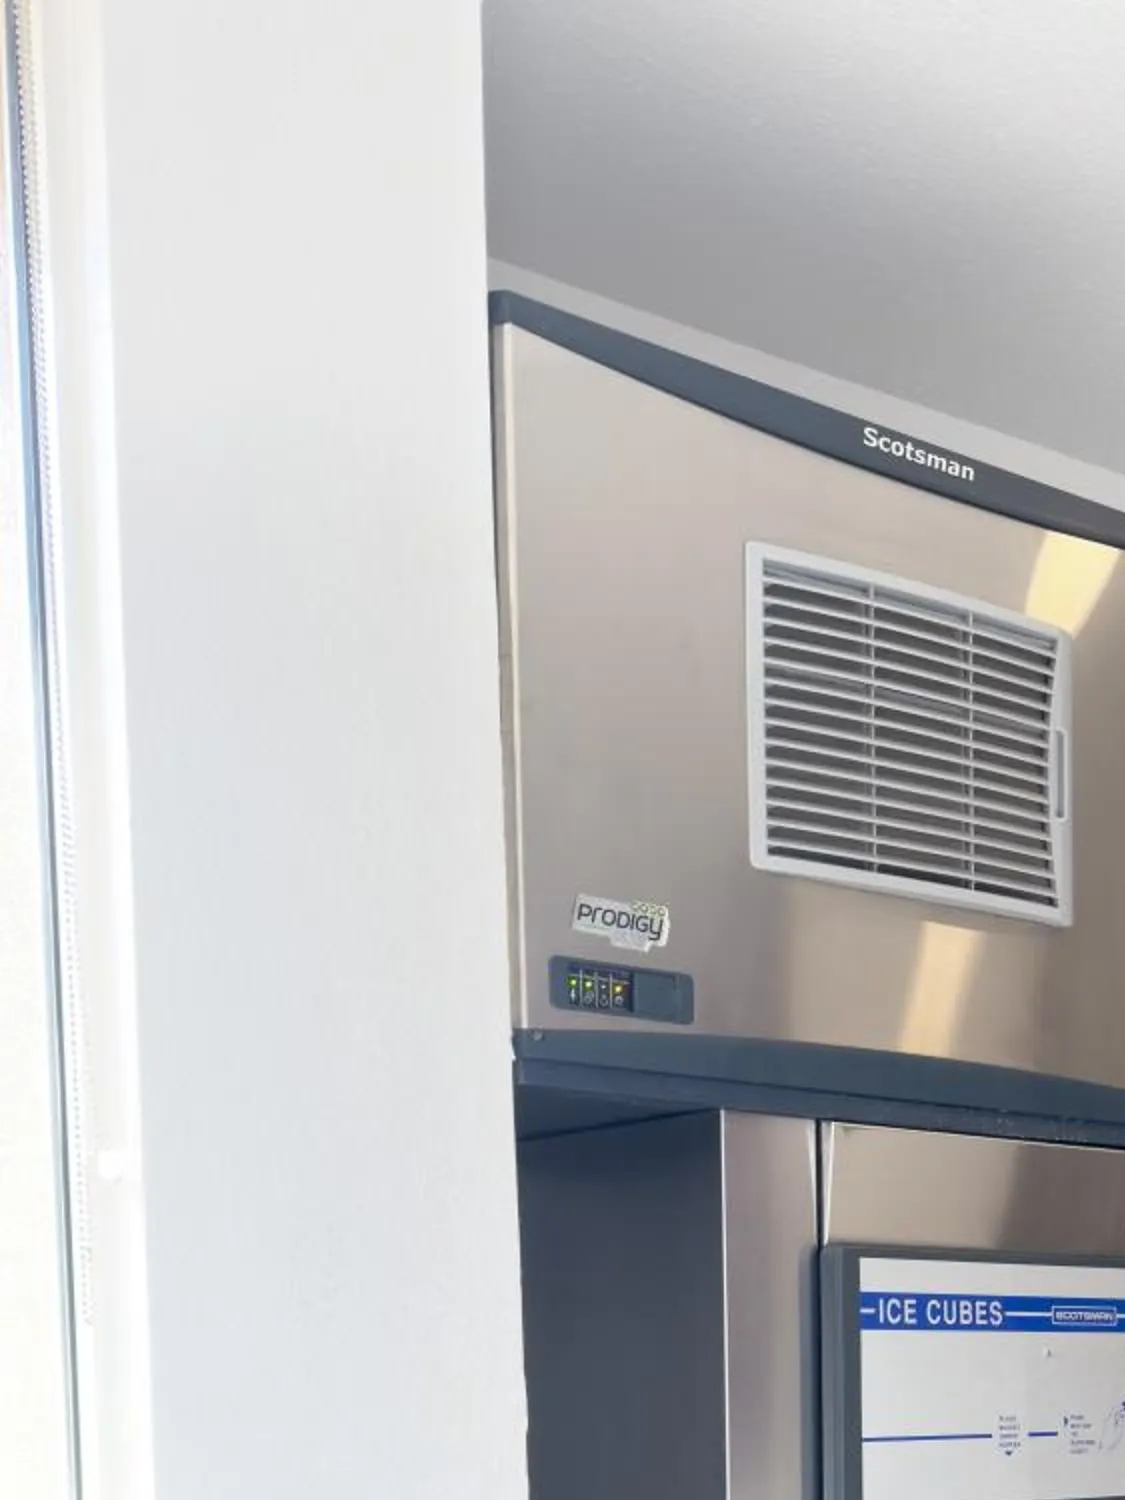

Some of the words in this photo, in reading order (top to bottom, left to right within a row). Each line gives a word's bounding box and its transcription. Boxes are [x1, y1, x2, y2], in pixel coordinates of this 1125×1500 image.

[863, 426, 975, 482] Scotsman
[879, 1297, 917, 1325] ICE
[926, 1299, 1004, 1326] CUBES
